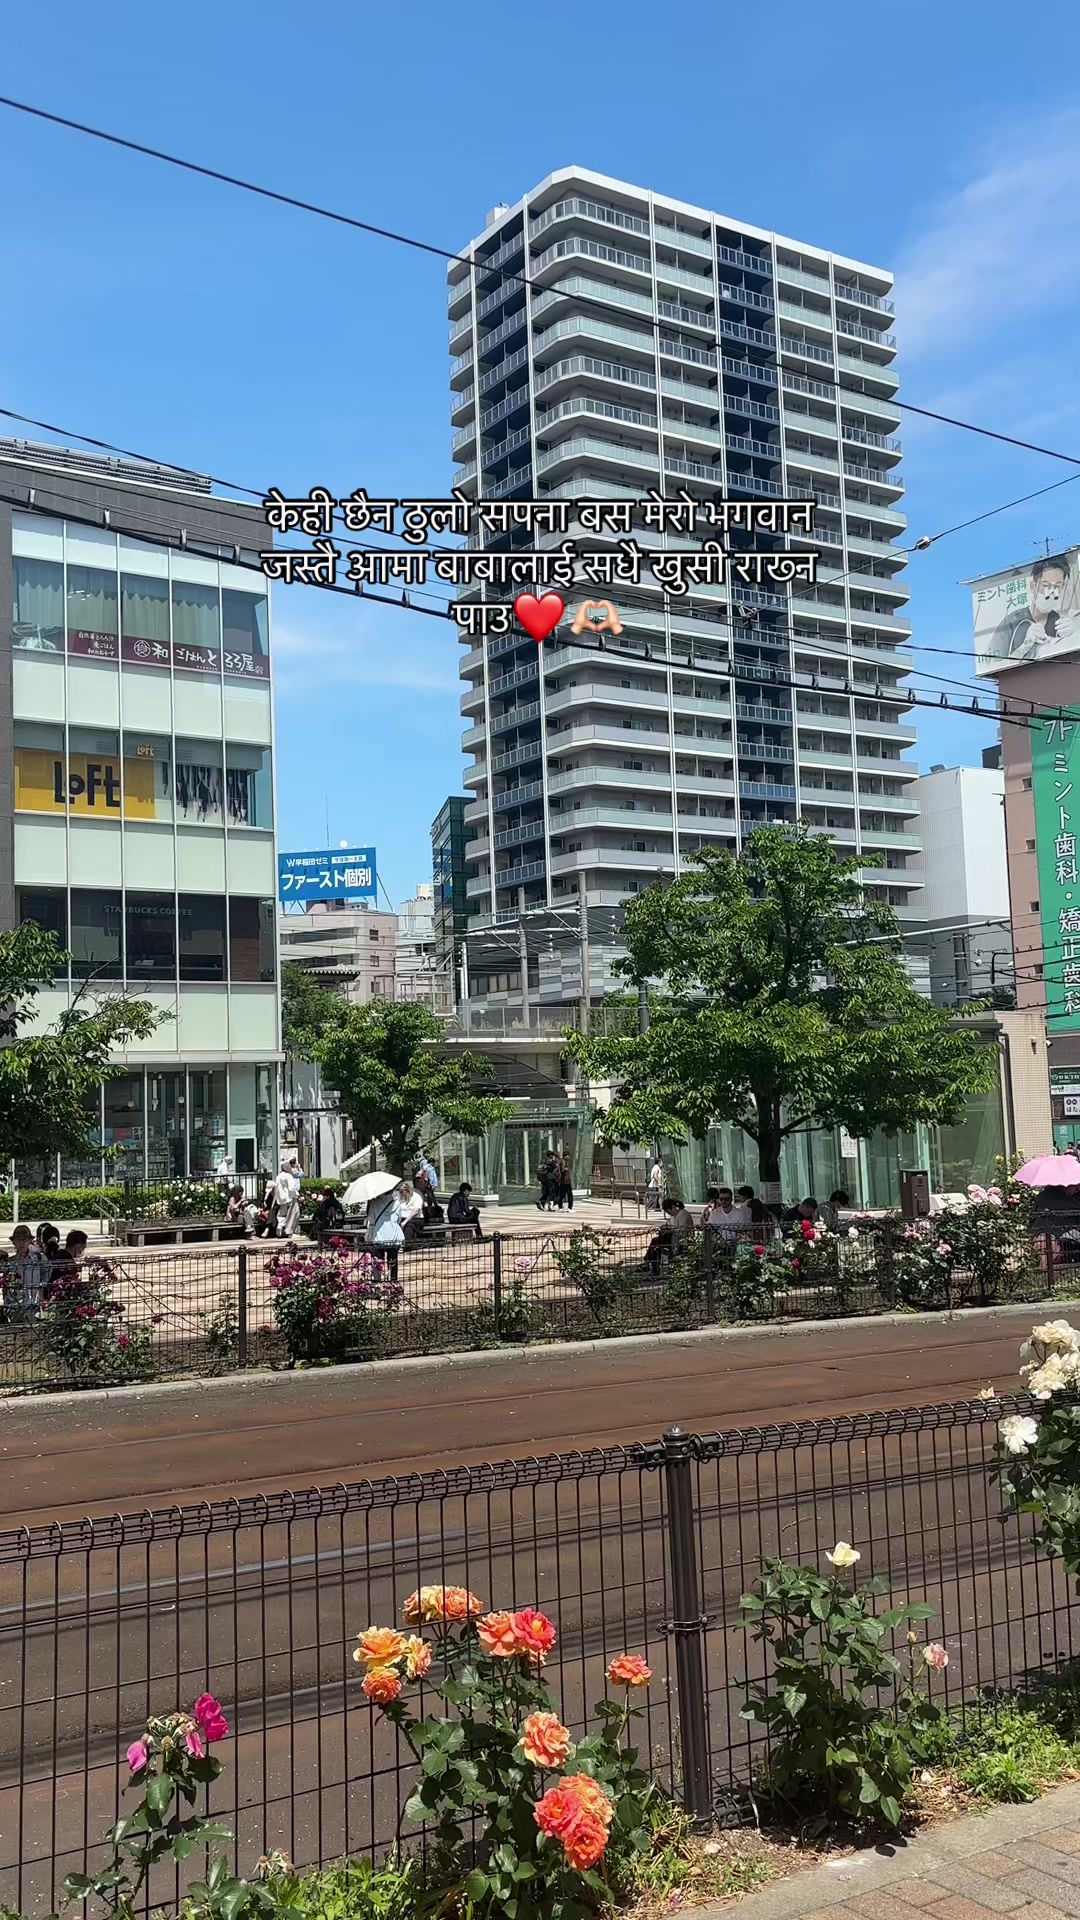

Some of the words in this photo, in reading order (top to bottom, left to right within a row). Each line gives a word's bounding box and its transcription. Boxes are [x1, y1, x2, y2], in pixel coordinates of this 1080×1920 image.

[280, 866, 372, 891] ファースト個別
